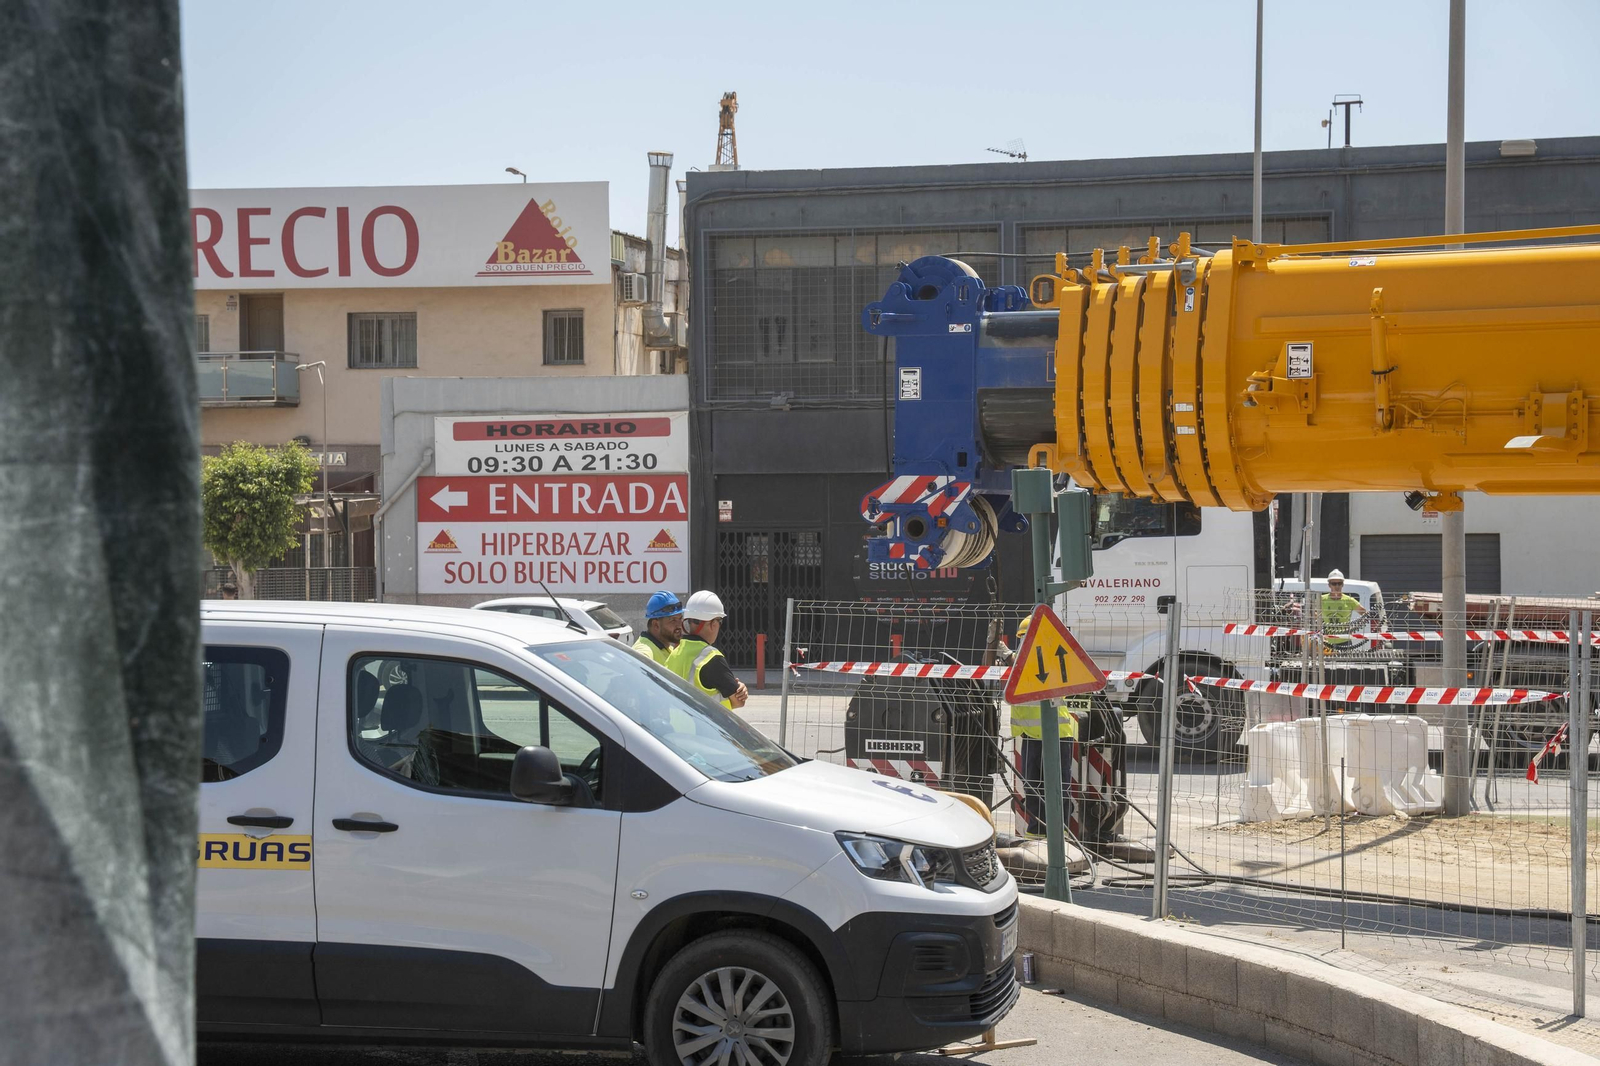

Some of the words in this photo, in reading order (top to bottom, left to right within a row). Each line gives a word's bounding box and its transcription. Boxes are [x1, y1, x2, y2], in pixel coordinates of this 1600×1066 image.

[539, 199, 578, 249] Rojo
[190, 205, 420, 278] RECIO
[496, 241, 571, 264] Bazar
[485, 264, 513, 272] SOLO
[546, 263, 586, 271] PRECIO
[486, 421, 637, 437] HORARIO
[495, 443, 545, 453] LUNES
[549, 443, 560, 452] A
[563, 441, 629, 451] SABADO
[467, 456, 543, 473] 09:30
[551, 455, 573, 472] A
[581, 453, 658, 471] 21:30
[489, 482, 686, 514] ENTRADA
[481, 532, 632, 556] HIPERBAZAR
[444, 561, 507, 584] SOLO
[514, 561, 577, 584] BUEN
[584, 561, 668, 584] PRECIO
[1089, 578, 1161, 588] VALERIANO
[1095, 595, 1109, 603] 902
[1113, 595, 1127, 603] 297
[1131, 595, 1145, 603] 298
[867, 741, 922, 751] LIEBHERR
[197, 841, 311, 862] RUAS
